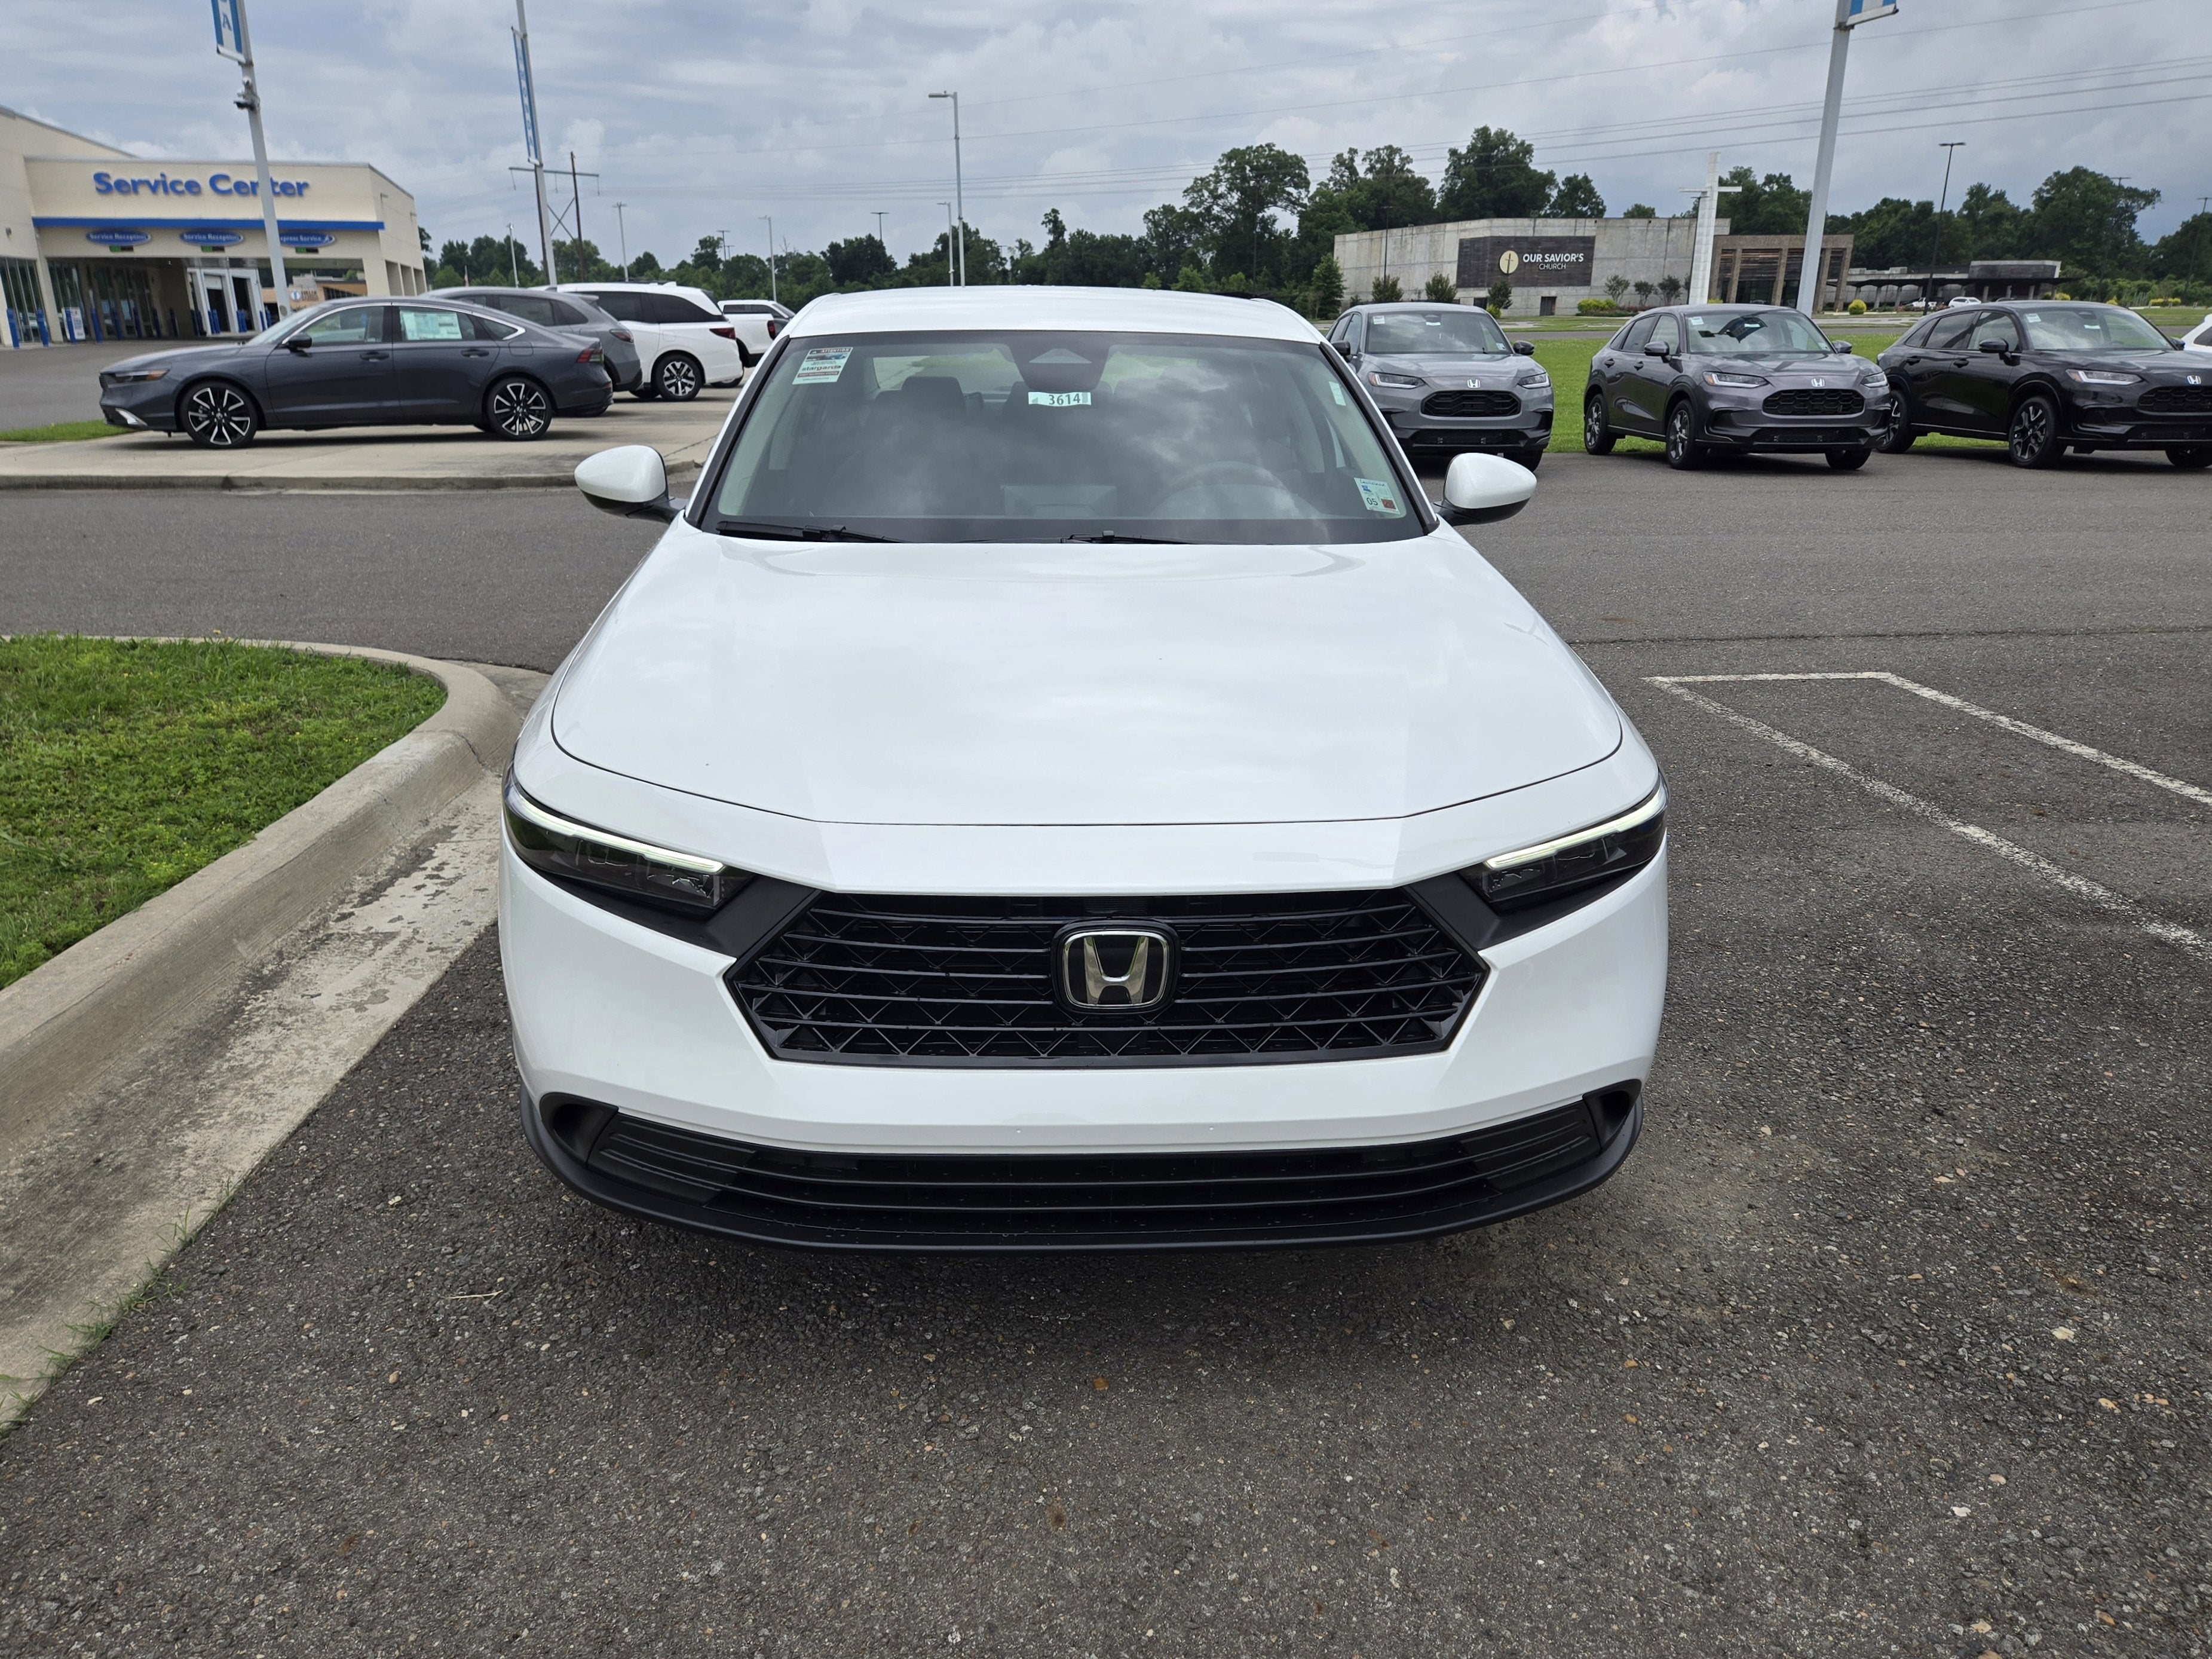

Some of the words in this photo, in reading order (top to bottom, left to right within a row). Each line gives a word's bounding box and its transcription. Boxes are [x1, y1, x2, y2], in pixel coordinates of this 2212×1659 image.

[93, 172, 202, 195] Service
[208, 173, 310, 197] Center
[1522, 253, 1543, 262] OUR
[1544, 253, 1584, 262] SAVIOR'S
[1049, 393, 1080, 405] 3614
[1367, 497, 1378, 506] 05
